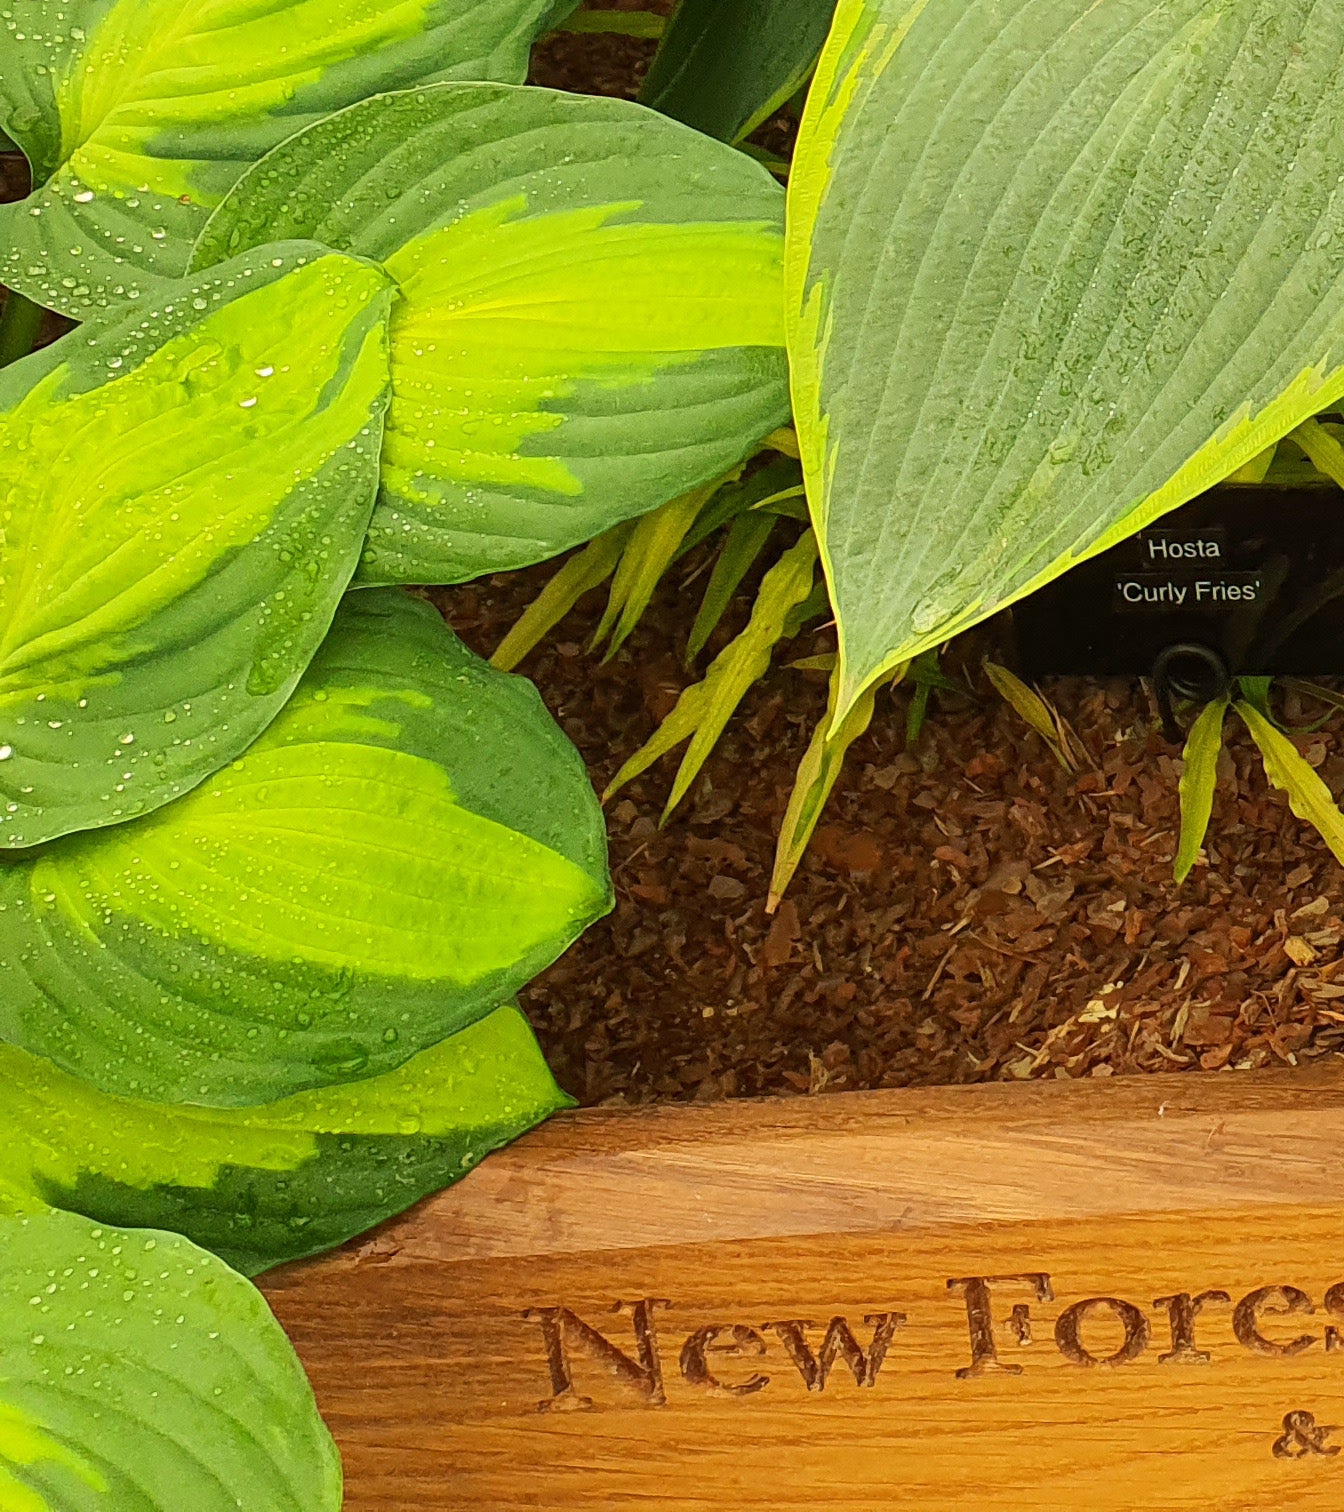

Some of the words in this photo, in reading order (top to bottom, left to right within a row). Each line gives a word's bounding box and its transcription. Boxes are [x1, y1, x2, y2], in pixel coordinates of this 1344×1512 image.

[1148, 539, 1221, 559] Hosta
[1117, 582, 1187, 605] 'Curly
[1195, 580, 1261, 601] Fries'
[520, 1297, 908, 1413] New
[1272, 1410, 1343, 1459] &
